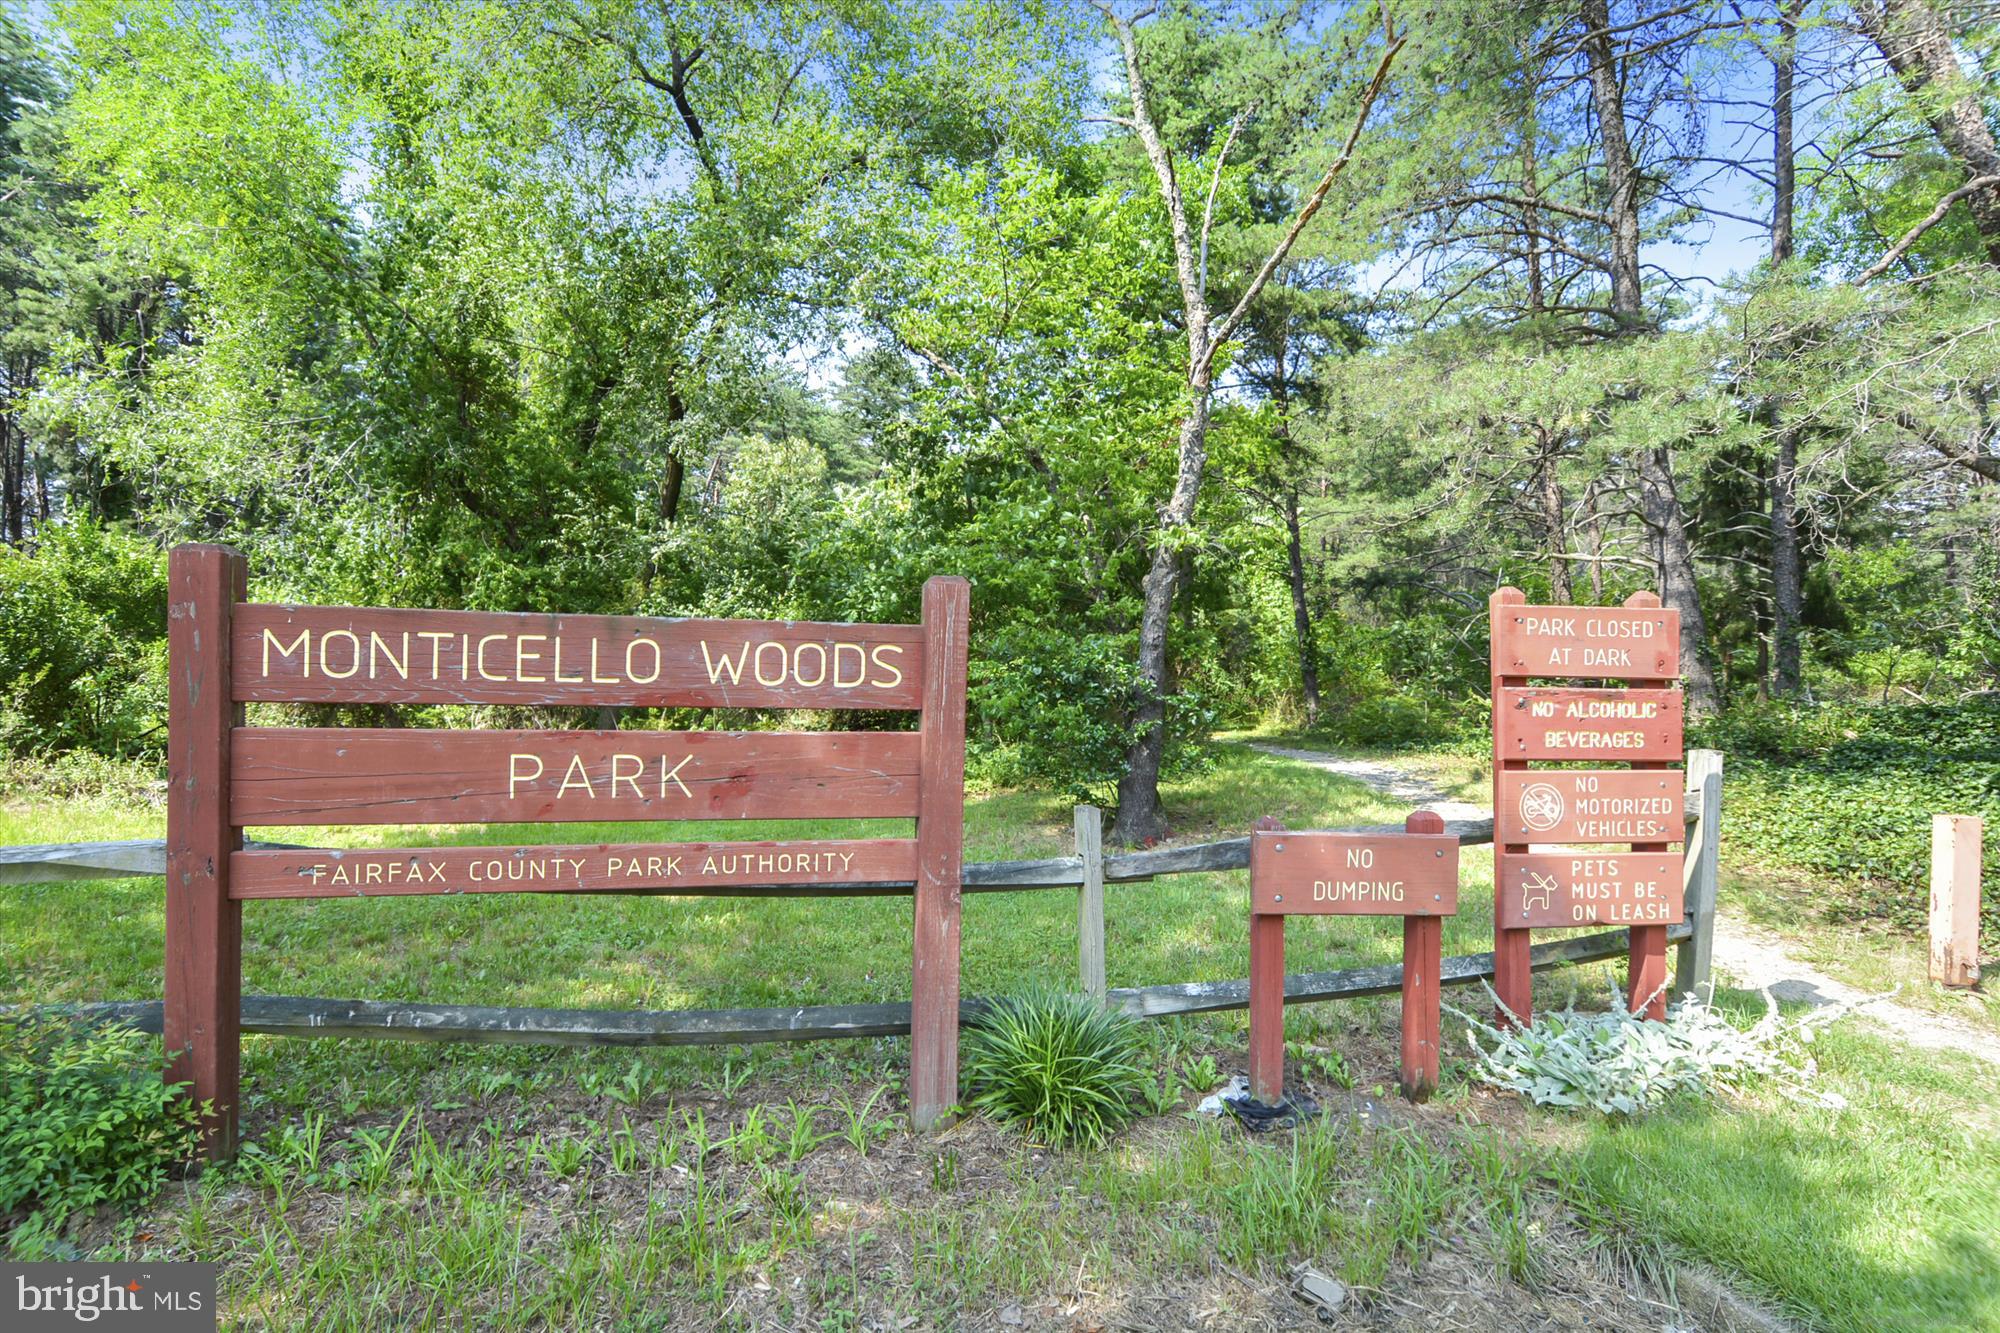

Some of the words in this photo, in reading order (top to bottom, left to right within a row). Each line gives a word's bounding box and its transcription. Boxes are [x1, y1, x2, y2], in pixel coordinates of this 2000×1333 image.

[1526, 617, 1575, 636] PARK
[1586, 619, 1653, 638] CLOSED
[262, 628, 661, 684] MONTICELLO
[700, 640, 904, 688] WOODS
[1549, 648, 1572, 665] AT
[1584, 649, 1631, 666] DARK
[1532, 702, 1554, 718] NO
[1566, 702, 1657, 719] ALCOHOLIC
[1545, 731, 1644, 748] BEVERAGES
[509, 753, 693, 799] PARK
[1576, 777, 1598, 793] NO
[1576, 798, 1672, 815] MOTORIZED
[1576, 820, 1657, 837] VEHICLES
[1347, 849, 1373, 868] NO
[312, 862, 447, 885] FAIRFAX
[469, 858, 586, 881] COUNTY
[607, 856, 682, 877] PARK
[702, 852, 855, 875] AUTHORITY
[1572, 860, 1618, 876] PETS
[1314, 881, 1404, 901] DUMPING
[1572, 882, 1621, 899] MUST
[1634, 882, 1656, 898] BE
[1572, 904, 1597, 921] ON
[1611, 903, 1669, 920] LEASH
